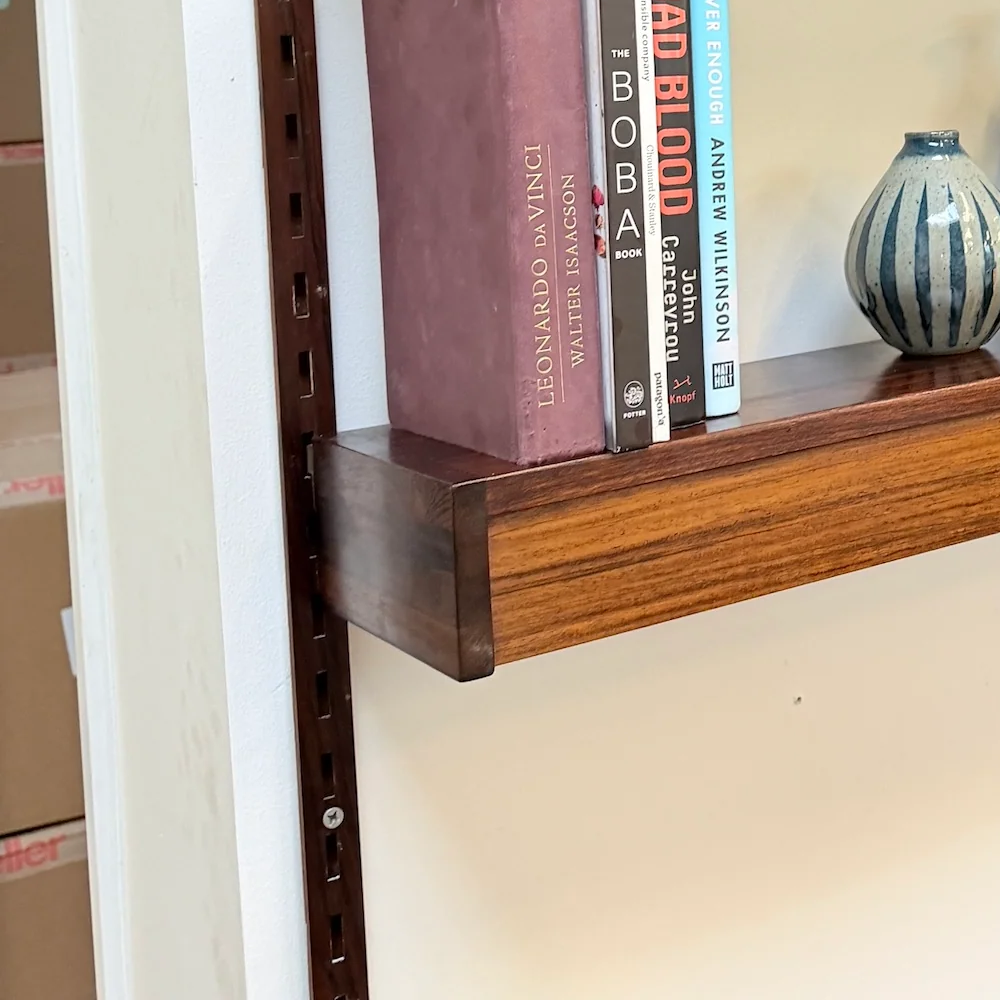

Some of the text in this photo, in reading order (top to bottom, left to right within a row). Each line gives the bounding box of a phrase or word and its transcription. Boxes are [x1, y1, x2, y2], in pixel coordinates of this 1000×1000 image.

[611, 49, 630, 58] THE
[641, 34, 650, 82] company
[707, 40, 724, 125] ENOUGH
[647, 144, 655, 194] Chouinard
[655, 75, 694, 216] BLOOD
[710, 137, 727, 221] ANDREW
[648, 202, 657, 236] Stanley
[524, 143, 555, 408] LEONARDO DA VINCI
[561, 174, 585, 368] WALTER ISAACSON
[615, 248, 643, 260] BOOK
[662, 235, 680, 362] Carreyrou
[681, 269, 698, 324] John
[714, 230, 730, 343] WILKINSON
[714, 361, 734, 376] MATT
[714, 375, 734, 389] HOLT
[623, 409, 646, 419] POTTER
[669, 390, 696, 405] Knopf
